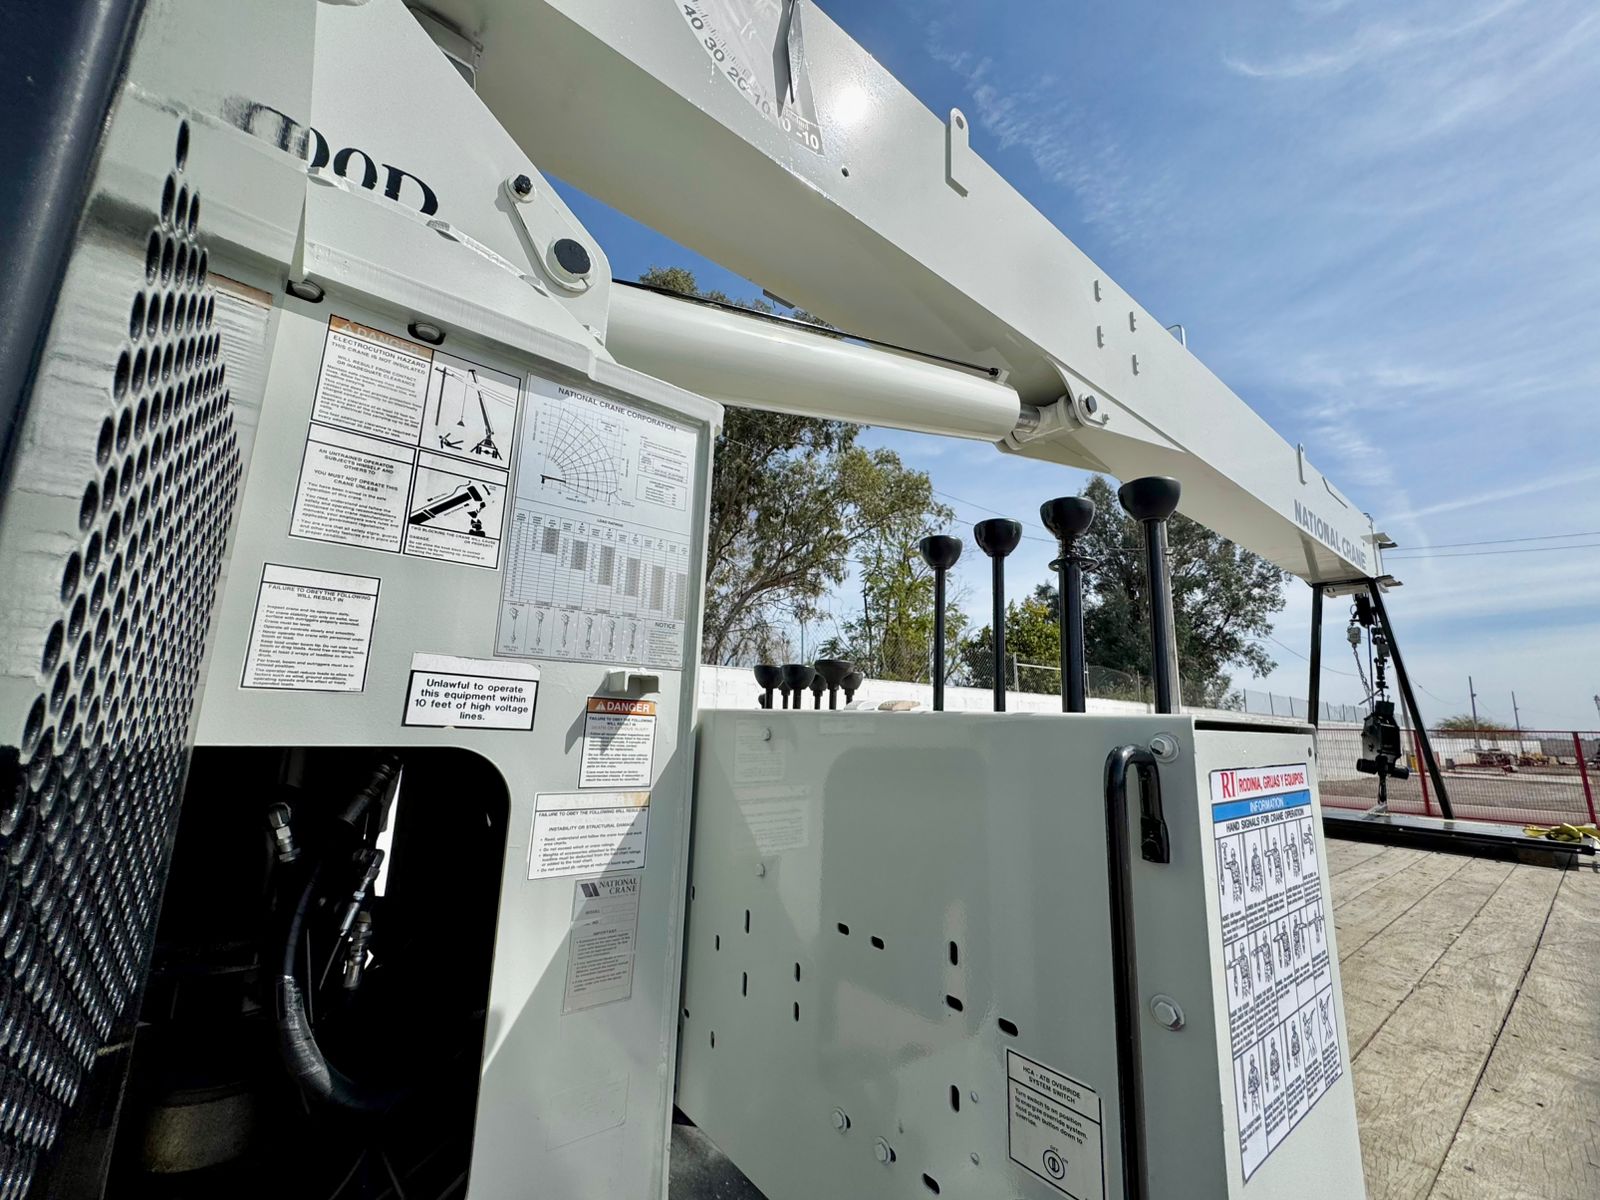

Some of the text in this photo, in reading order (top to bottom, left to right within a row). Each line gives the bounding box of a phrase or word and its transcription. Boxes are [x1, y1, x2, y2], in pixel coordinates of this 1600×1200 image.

[682, 4, 704, 30] 40
[704, 37, 725, 62] 30
[754, 94, 770, 115] 10
[782, 119, 792, 132] 0
[796, 132, 819, 150] -10
[332, 342, 346, 350] THIS
[348, 346, 369, 357] CRANE
[393, 361, 426, 375] INSULATED
[333, 335, 426, 369] ELECTROCUTION HAZARD
[347, 363, 382, 377] INADEQUATE
[383, 374, 415, 387] CLEARANCE
[353, 360, 374, 369] RESULT
[392, 372, 416, 382] CONTACT
[558, 386, 676, 432] NATIONAL CRANE CORPORATION
[324, 455, 355, 465] SUBJECTS
[356, 462, 380, 471] HIMSELF
[329, 451, 362, 462] UNTRAINED
[364, 459, 394, 469] OPERATOR
[344, 465, 367, 473] OTHERS
[356, 484, 378, 492] UNLESS
[359, 479, 384, 488] OPERATE
[1294, 499, 1367, 570] NATIONAL CRANE
[426, 678, 524, 694] Unlawful to operate
[421, 689, 526, 703] this equipment within
[414, 699, 427, 707] 10
[431, 700, 452, 708] feet
[470, 702, 491, 712] high
[494, 704, 528, 714] voltage
[459, 712, 486, 720] lines.
[607, 702, 650, 712] DANGER
[1220, 772, 1236, 798] RI
[1263, 774, 1280, 789] GRUAS
[1280, 774, 1284, 787] Y
[1284, 772, 1304, 786] EQUIPOS
[1250, 797, 1284, 813] INFORMATION
[1226, 808, 1304, 832] HAND SIGNALS FOR CRANE OPERATION
[599, 878, 637, 888] NATIONAL
[609, 885, 636, 895] CRANE
[1029, 1076, 1075, 1105] SYSTEM SWITCH
[1039, 1073, 1050, 1084] ATB
[1052, 1079, 1080, 1099] OVERRIDE
[1015, 1087, 1026, 1098] Turn
[1027, 1094, 1043, 1108] switch
[1059, 1111, 1082, 1129] position
[1016, 1103, 1082, 1145] Hold push button down to
[1021, 1099, 1042, 1116] energize
[1043, 1111, 1065, 1127] override
[1066, 1123, 1088, 1140] system.
